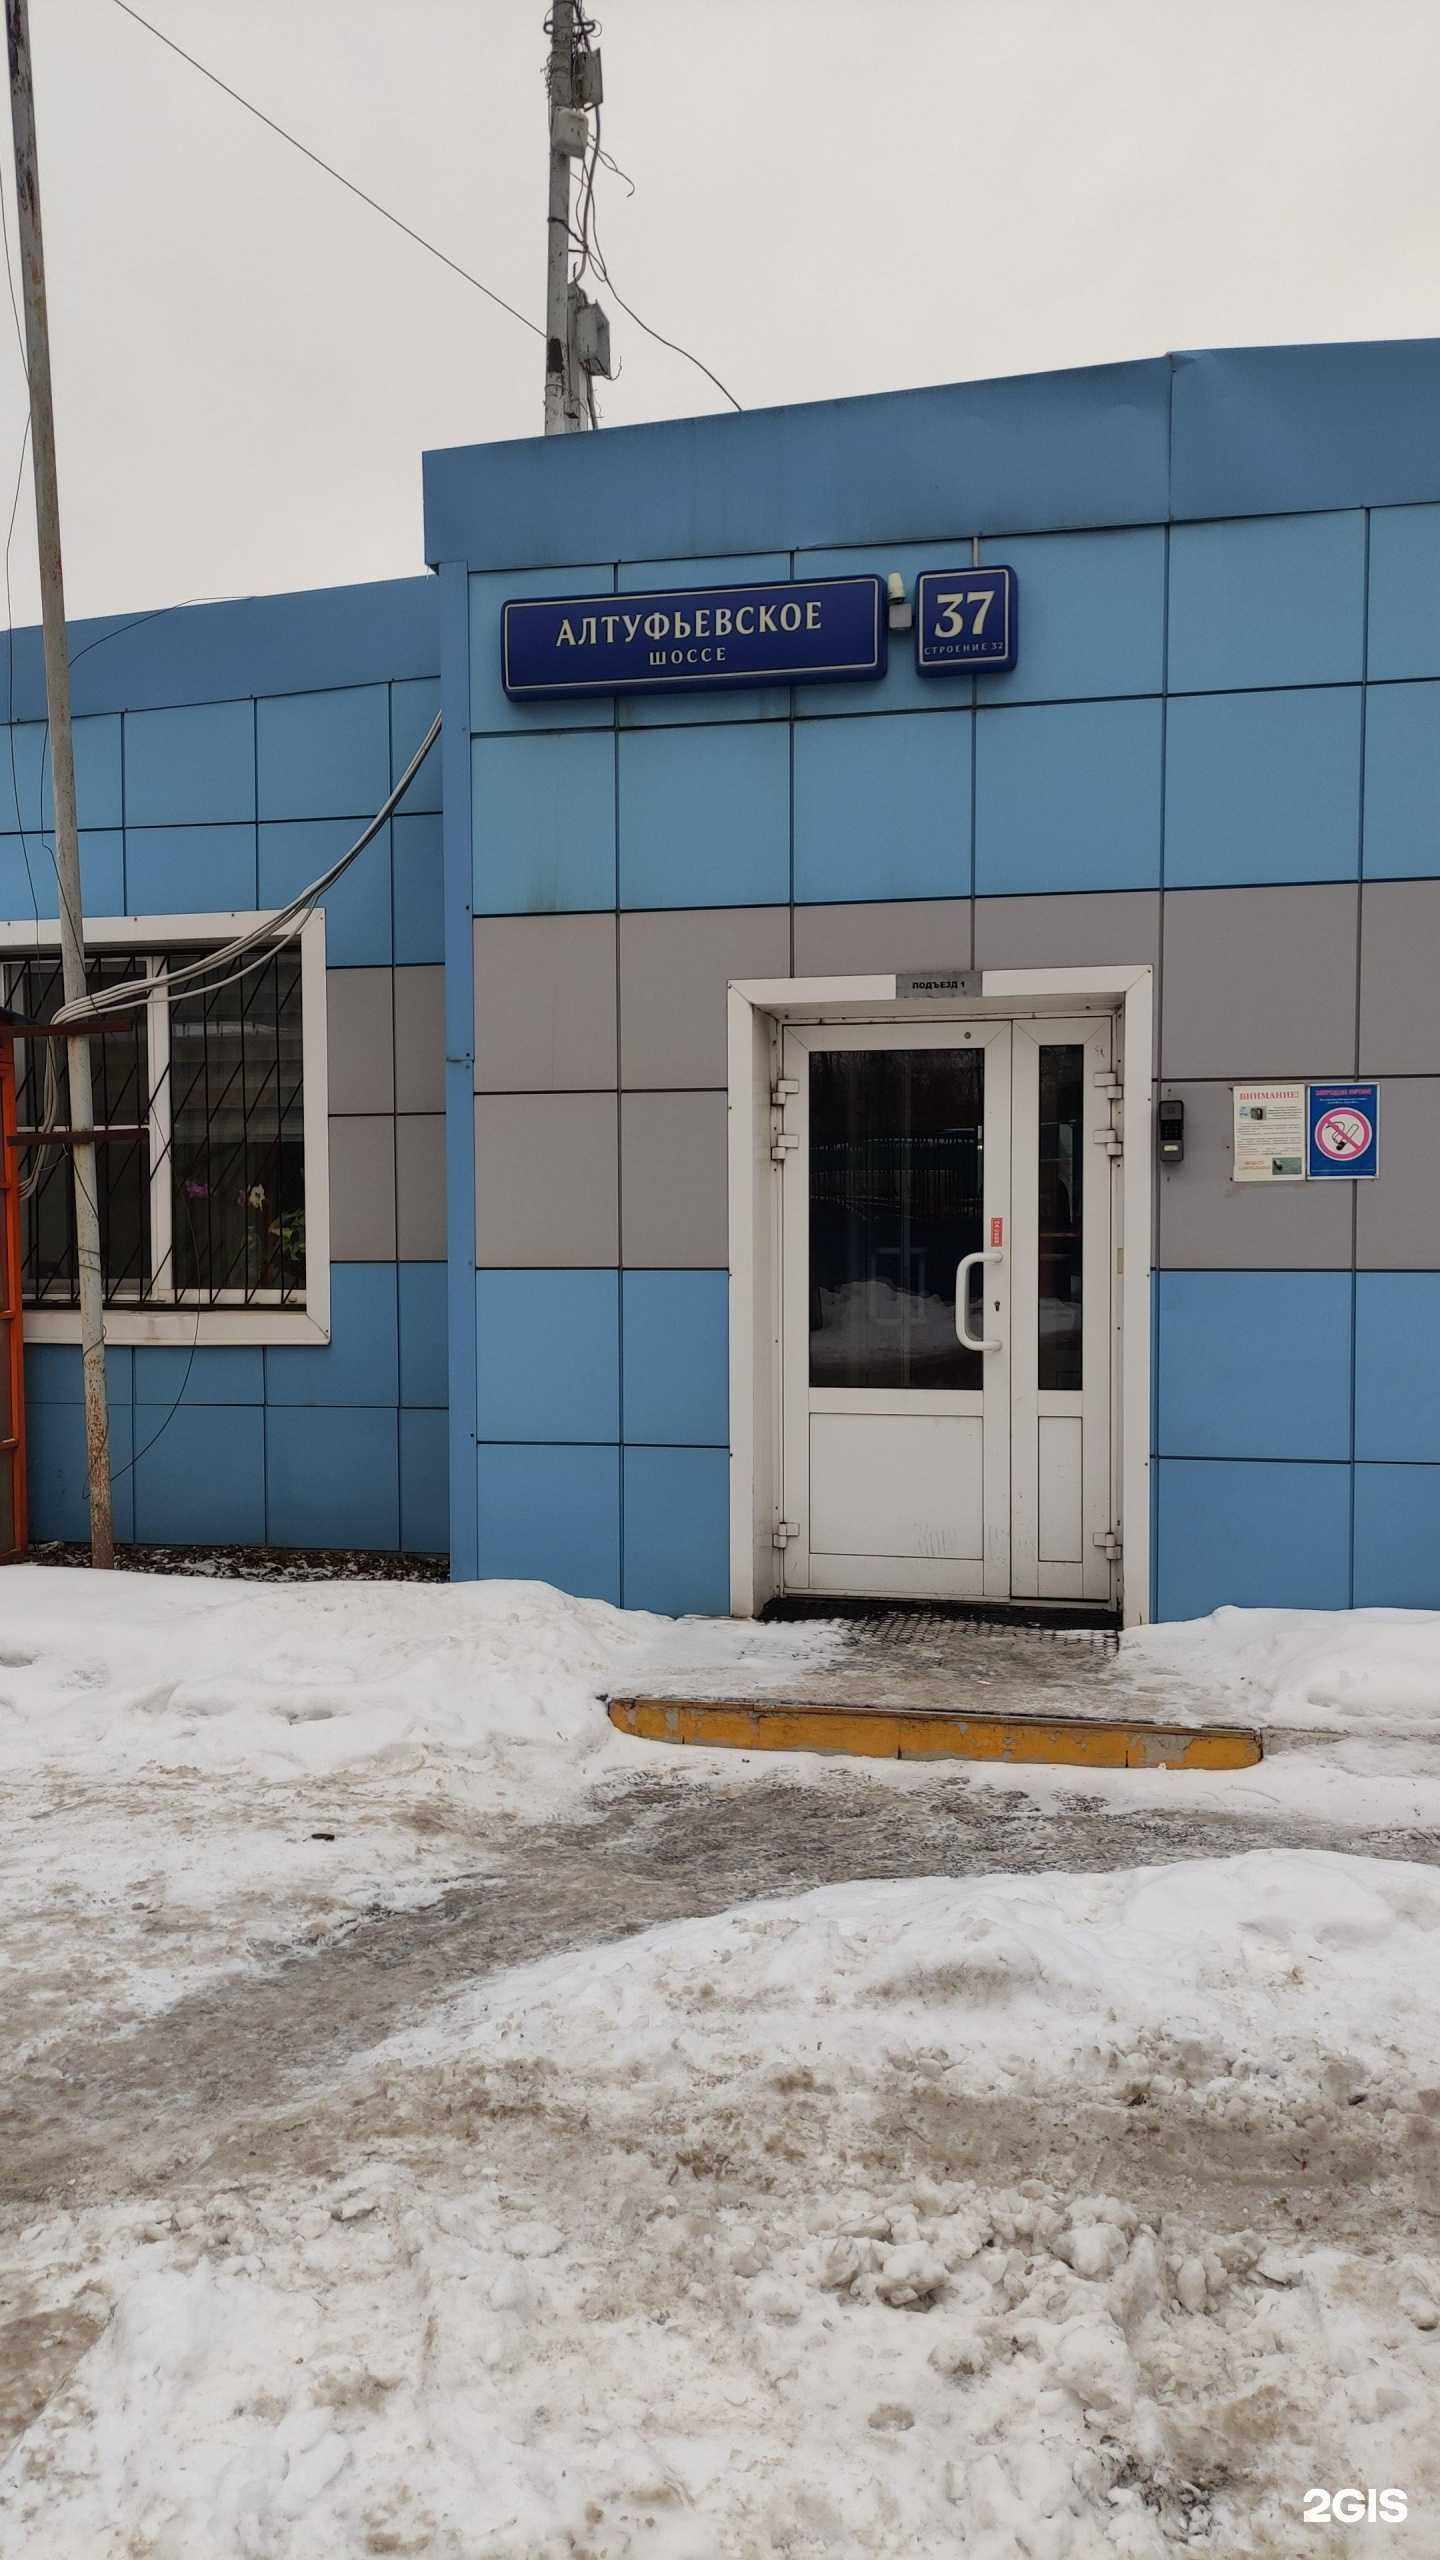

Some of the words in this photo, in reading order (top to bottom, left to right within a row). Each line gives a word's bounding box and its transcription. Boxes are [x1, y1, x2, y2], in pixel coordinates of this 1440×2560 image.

[934, 590, 995, 638] 37
[555, 601, 822, 648] АЛТУФЬЕВСКОЕ
[649, 647, 727, 666] ШОССЕ
[924, 642, 988, 655] СТРОЕНИЕ
[911, 980, 959, 990] ПОДЪЕЗД
[960, 980, 966, 989] 1
